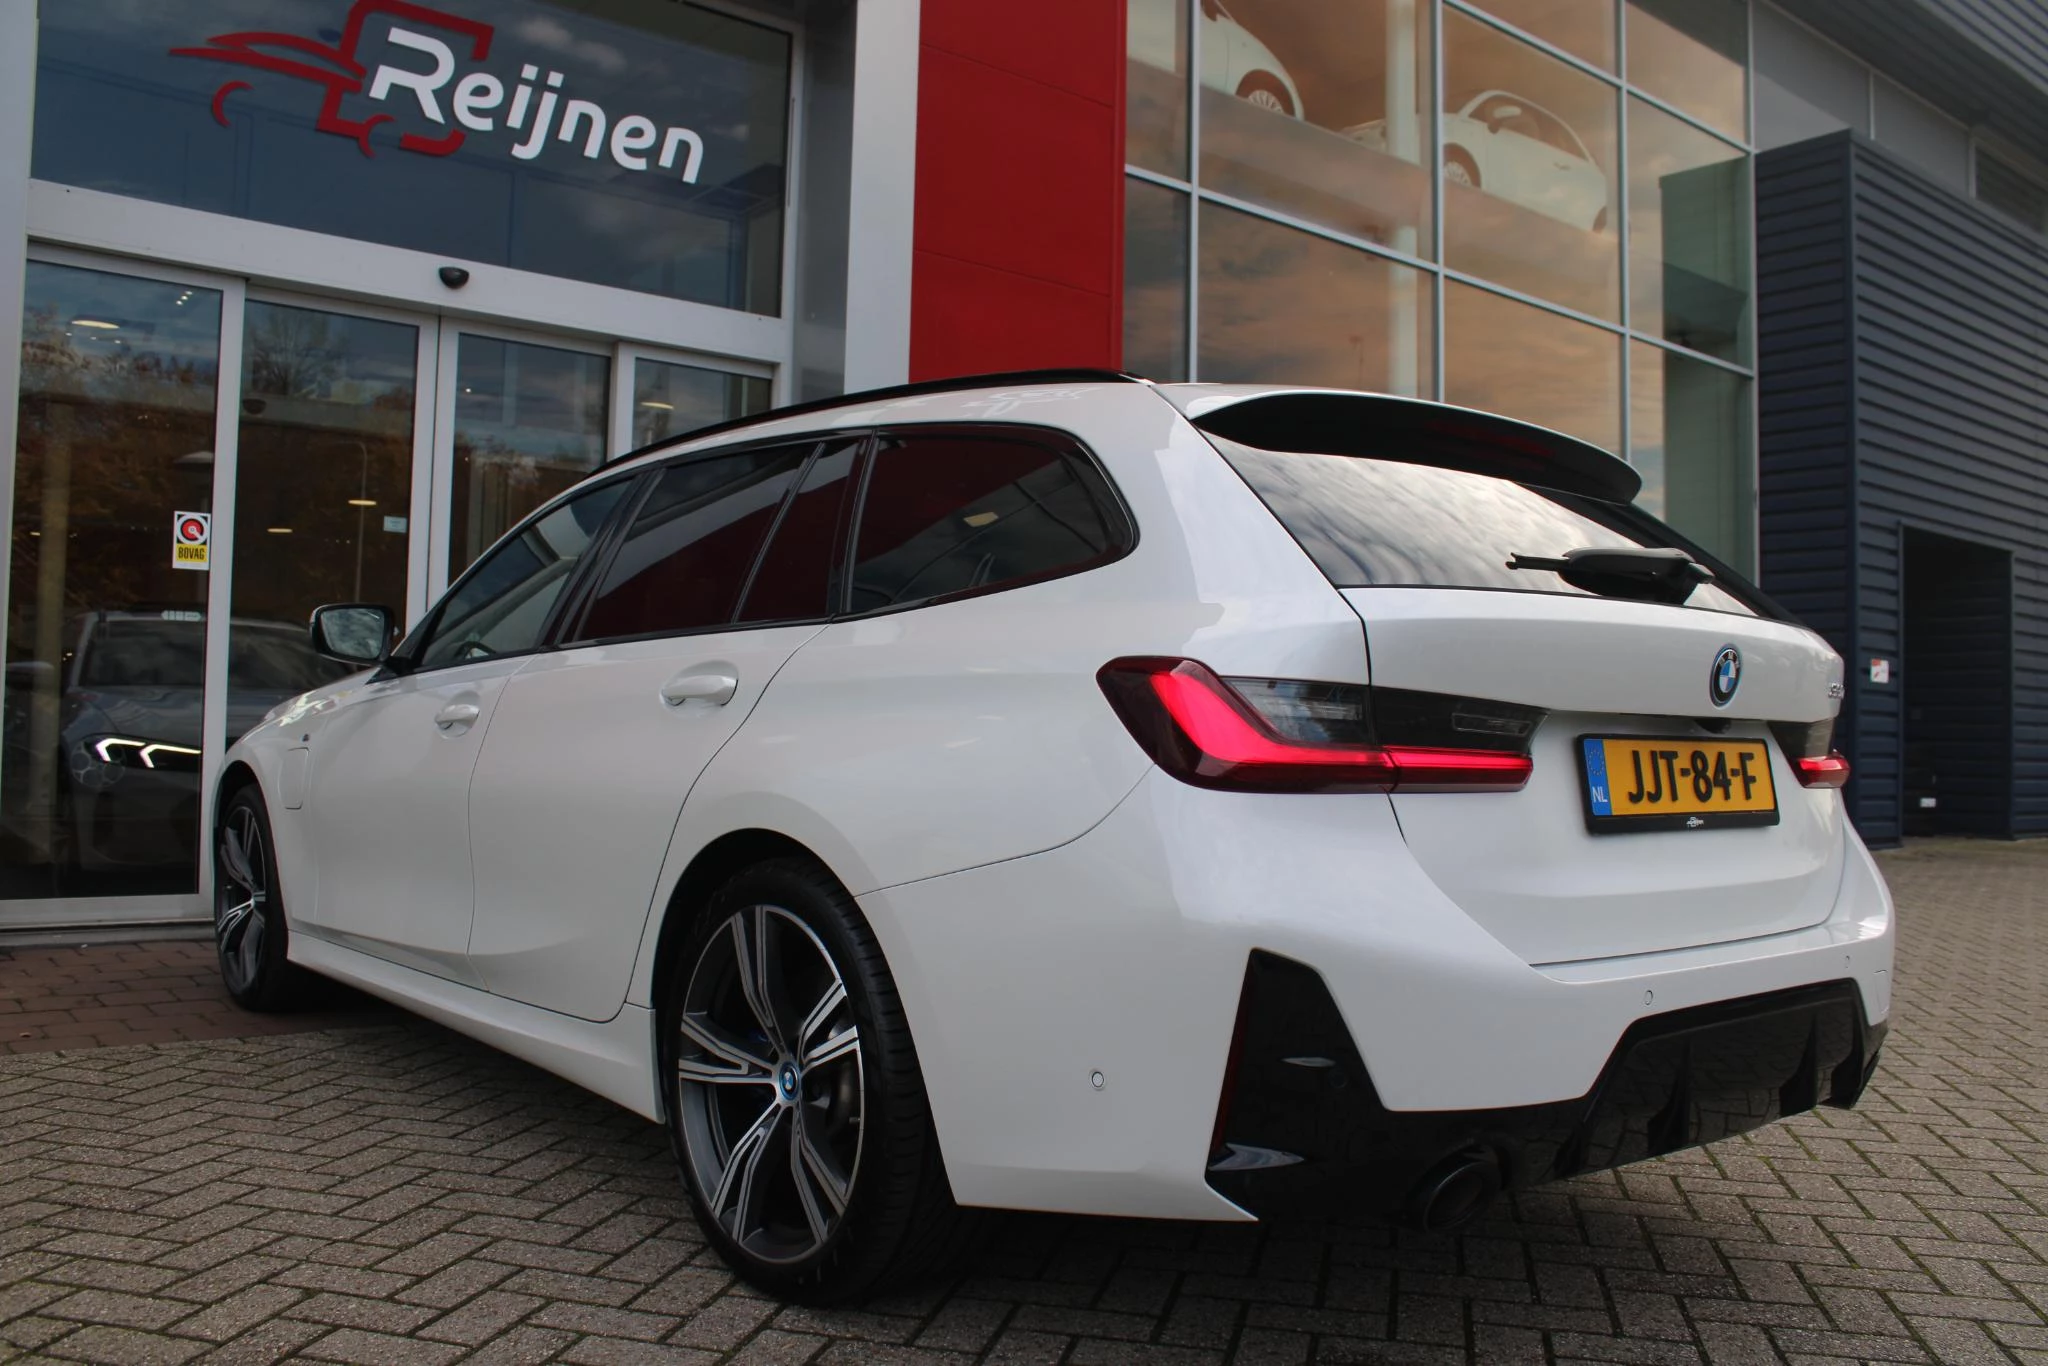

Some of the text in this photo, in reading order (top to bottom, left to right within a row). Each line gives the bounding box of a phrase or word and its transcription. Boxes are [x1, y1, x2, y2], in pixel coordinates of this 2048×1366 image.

[368, 26, 704, 184] Reijnen
[178, 546, 205, 560] BOVAG
[1592, 786, 1608, 803] NL
[1628, 750, 1757, 804] JJT-84-F
